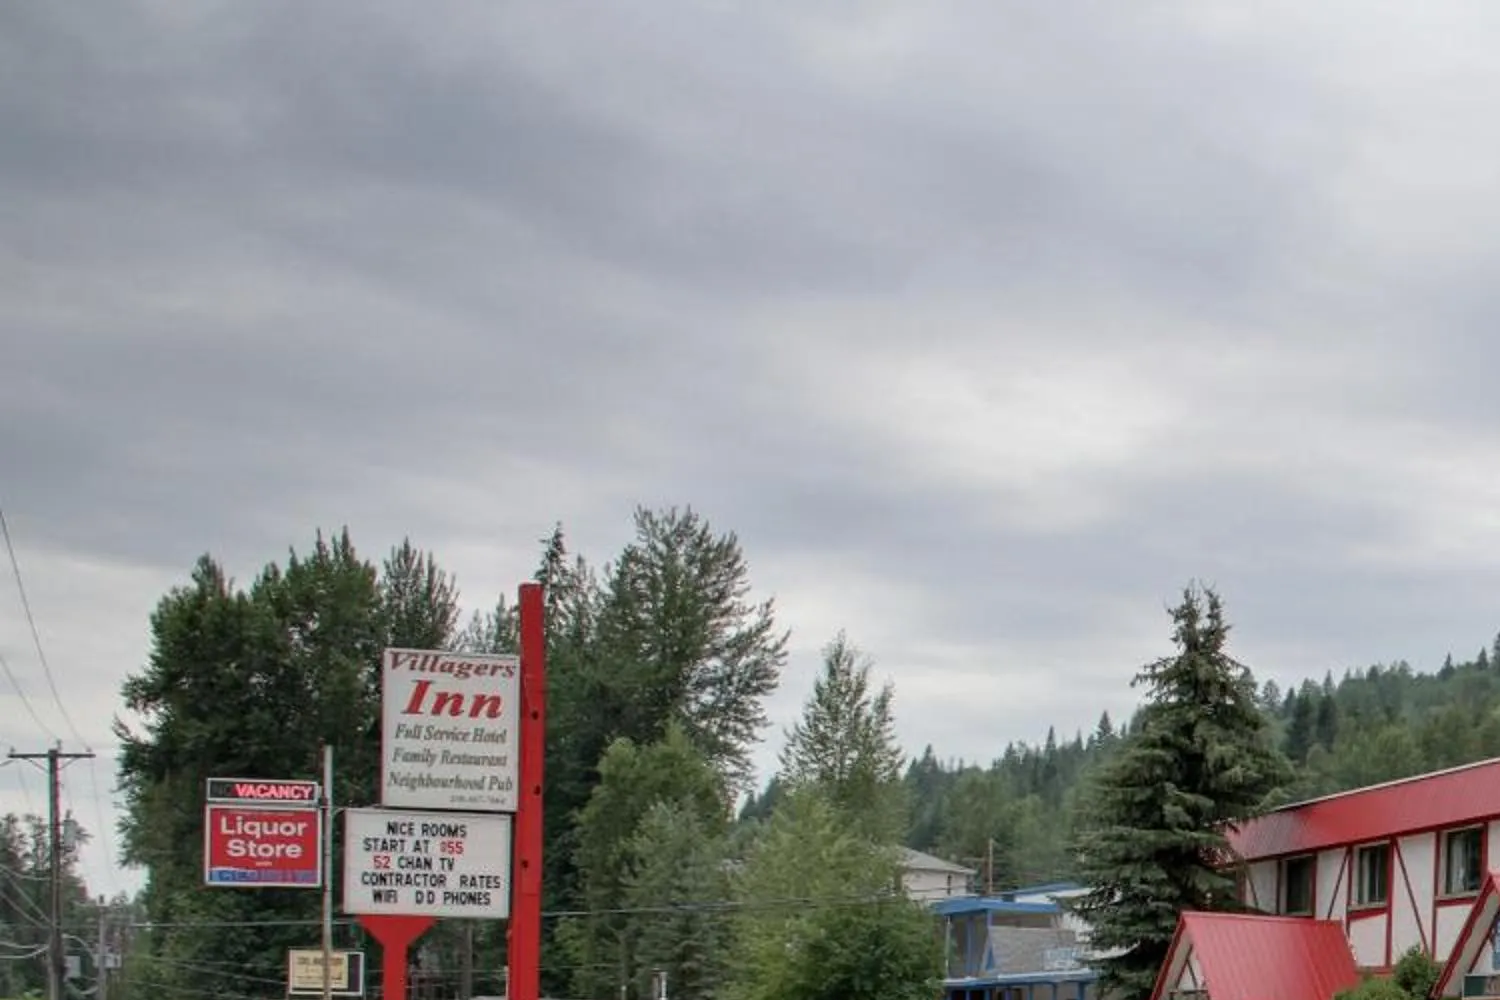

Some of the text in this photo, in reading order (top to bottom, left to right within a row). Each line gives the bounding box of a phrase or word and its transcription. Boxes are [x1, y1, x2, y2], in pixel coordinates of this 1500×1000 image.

[389, 652, 516, 679] Villagers
[400, 679, 503, 719] Inn
[395, 723, 507, 743] Full Service Hotel
[392, 747, 508, 768] Family Restaurant
[235, 783, 313, 799] VACANCY
[387, 771, 513, 791] Neighbourhood Pub
[220, 816, 308, 839] Liquor
[387, 821, 467, 838] NICE ROOMS
[226, 838, 302, 858] Store
[363, 837, 406, 852] START
[413, 839, 430, 853] AT
[373, 855, 455, 871] 52 CHAN TV
[361, 872, 501, 889] CONTRACTOR RATES
[443, 891, 491, 906] PHONES
